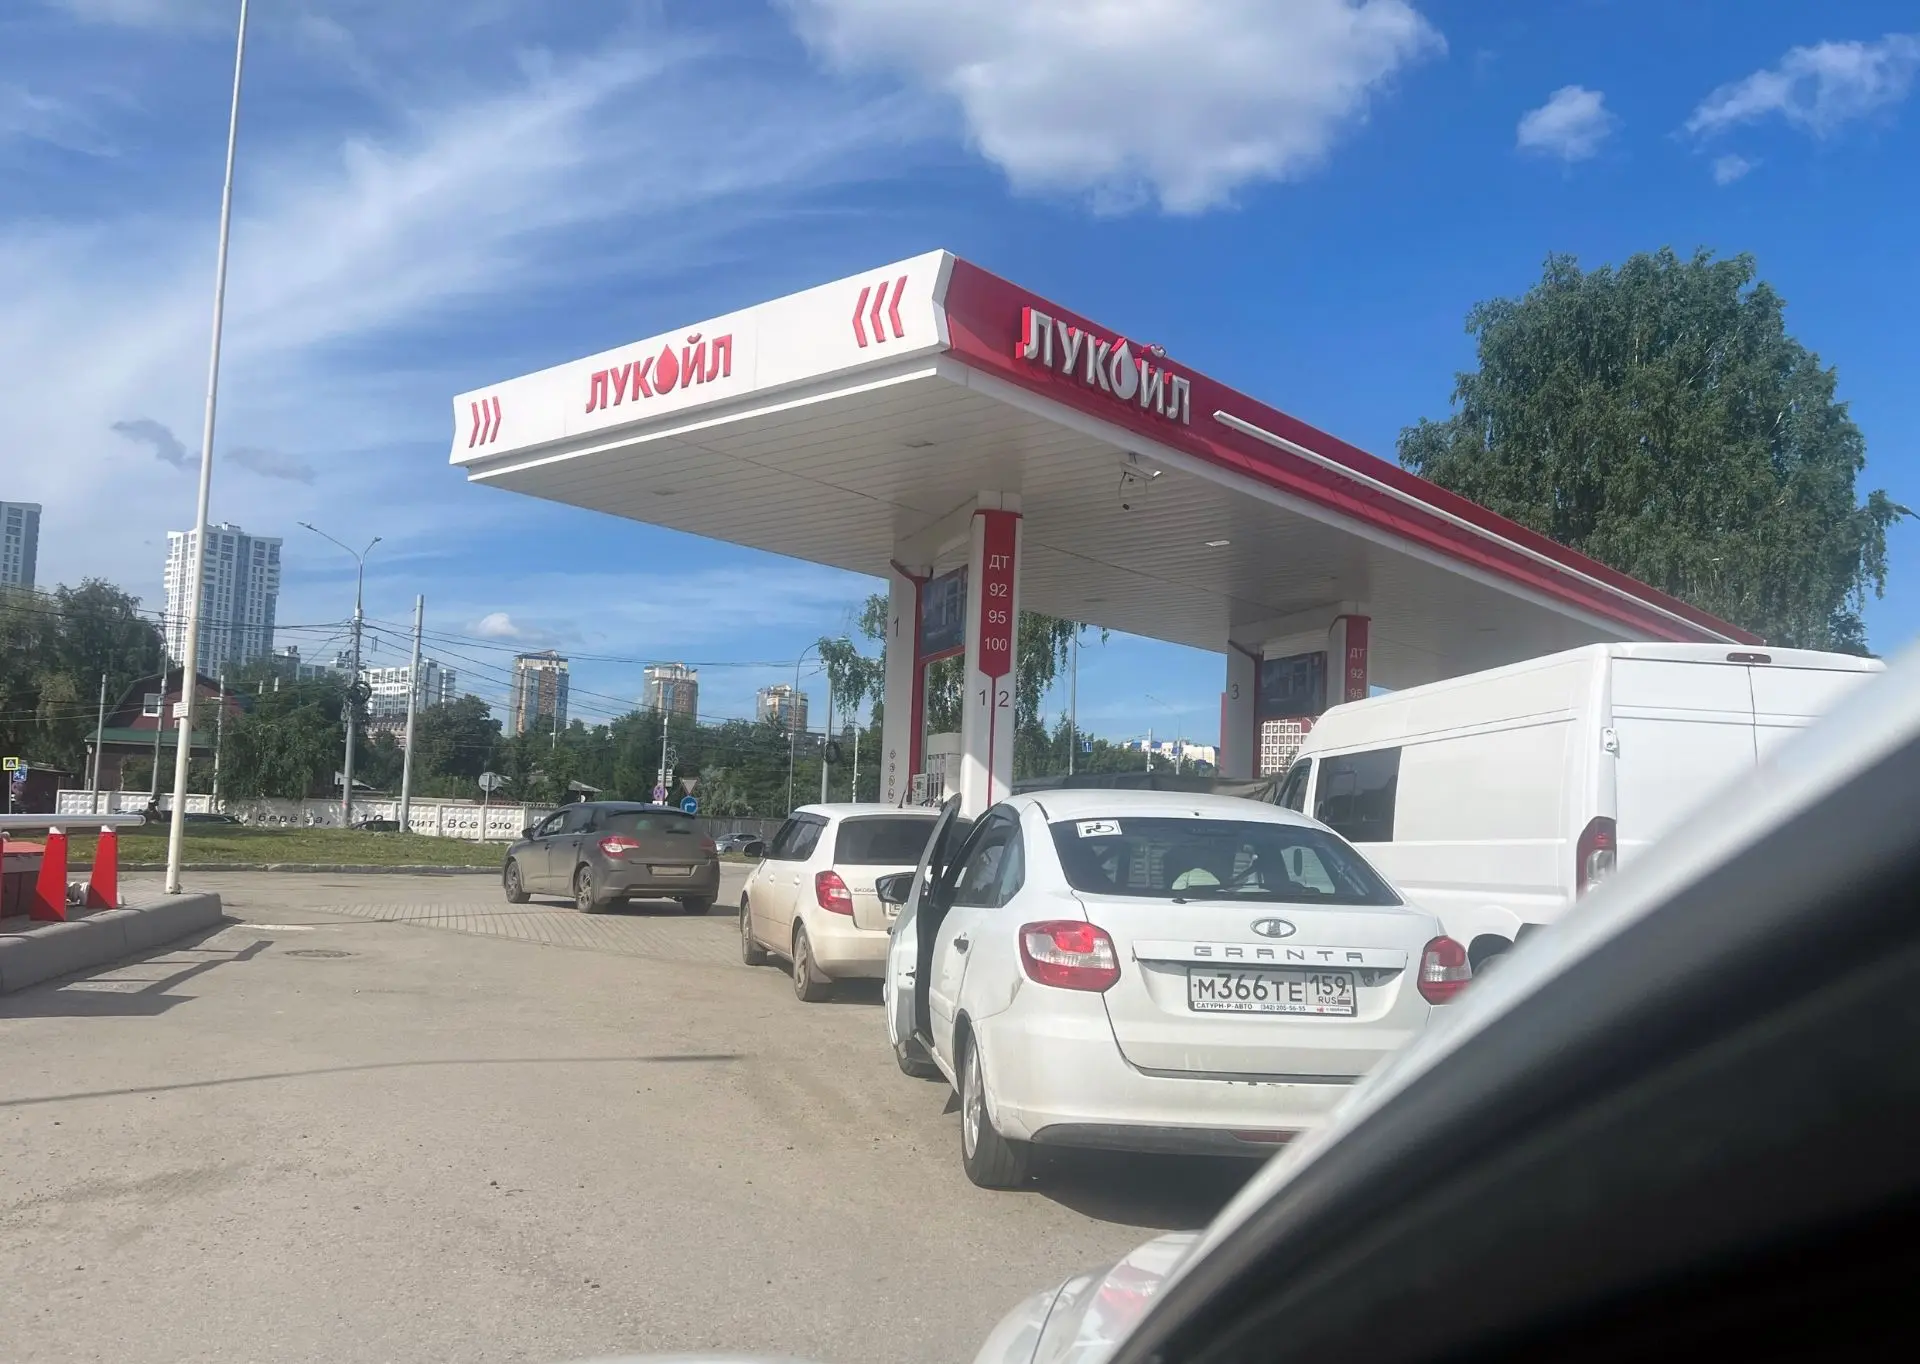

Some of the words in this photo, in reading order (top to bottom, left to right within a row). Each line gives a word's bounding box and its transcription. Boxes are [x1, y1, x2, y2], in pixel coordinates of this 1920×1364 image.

[585, 332, 733, 414] ЛУКОЙЛ
[1017, 307, 1191, 425] ЛУКОЙЛ
[988, 554, 1010, 570] ДТ
[989, 582, 1008, 597] 92
[988, 609, 1007, 624] 95
[893, 616, 900, 638] 1
[984, 637, 1008, 651] 100
[1350, 647, 1364, 659] ДТ
[1350, 668, 1364, 679] 92
[979, 689, 987, 706] 1
[998, 690, 1010, 708] 2
[1231, 683, 1240, 700] 3
[1350, 687, 1363, 699] 95
[447, 818, 479, 829] Все
[489, 820, 512, 830] это
[1194, 945, 1364, 963] GRANTA
[1309, 974, 1347, 997] 159
[1196, 1002, 1253, 1010] САТУРН-Р-АВТО
[1318, 996, 1337, 1005] RUS
